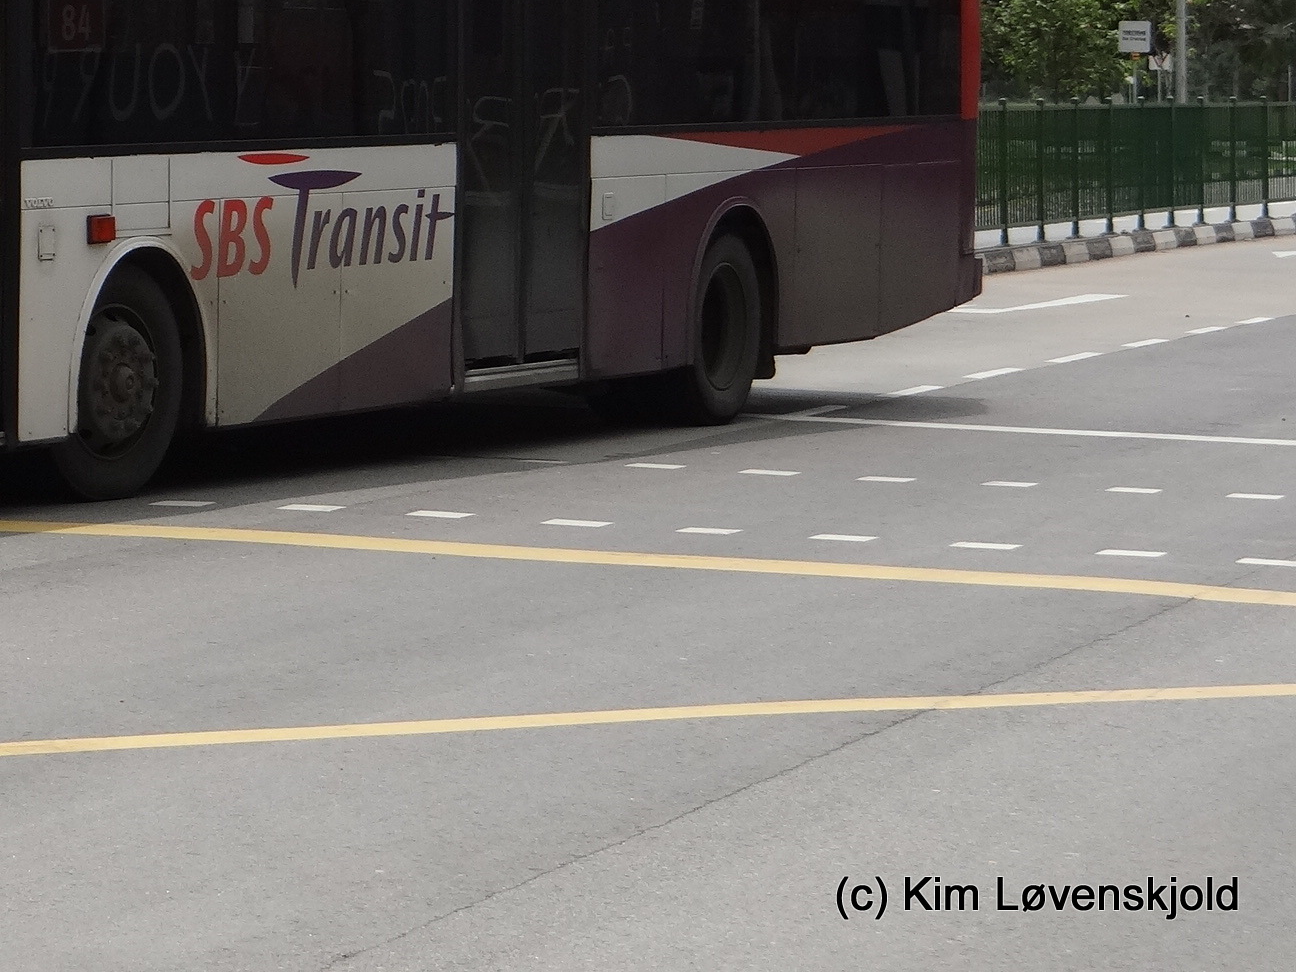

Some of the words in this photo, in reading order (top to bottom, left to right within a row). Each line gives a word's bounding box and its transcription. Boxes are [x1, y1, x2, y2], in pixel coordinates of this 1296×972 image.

[61, 4, 91, 42] 84
[190, 196, 275, 281] SBS
[267, 169, 456, 289] Transit
